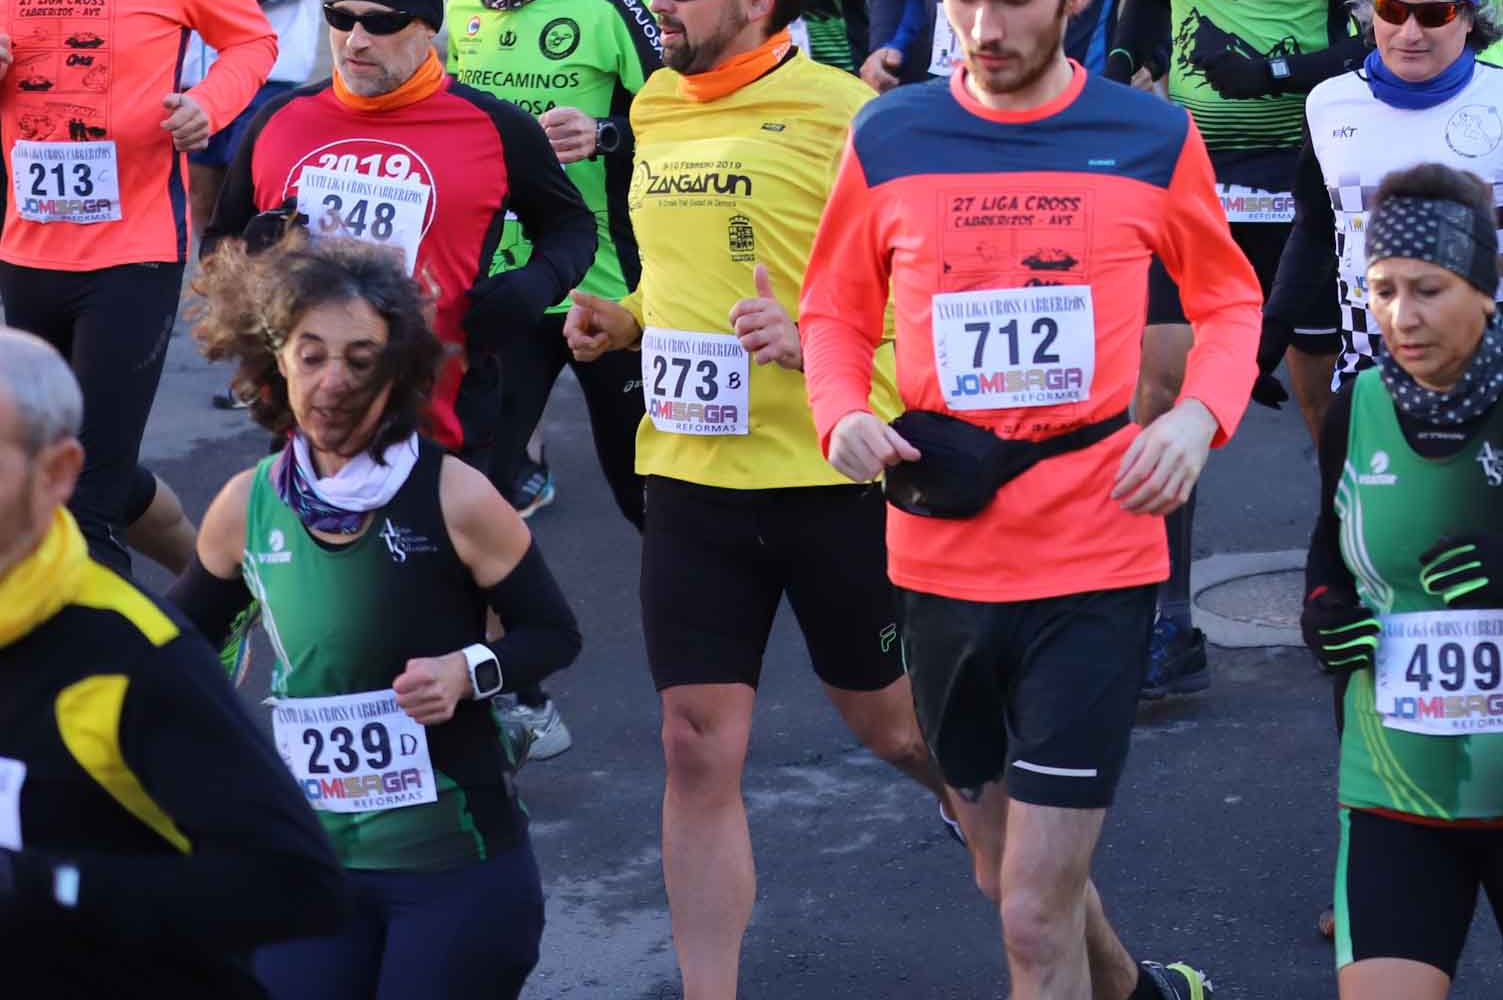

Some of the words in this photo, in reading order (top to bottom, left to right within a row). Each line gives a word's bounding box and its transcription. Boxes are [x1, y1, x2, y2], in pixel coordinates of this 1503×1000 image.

[318, 153, 411, 178] 2019
[29, 162, 94, 197] 213
[953, 196, 975, 212] 27
[981, 196, 1019, 211] LIGA
[1025, 195, 1081, 211] CROSS
[319, 194, 396, 240] 348
[989, 297, 1022, 316] CROSS
[1024, 295, 1087, 313] CABRERIZOS
[691, 341, 743, 358] CABRERIZOS
[964, 317, 1061, 369] 712
[653, 355, 719, 402] 273
[727, 371, 742, 390] B
[950, 367, 1084, 397] JOMISAGA
[650, 399, 738, 423] OMISAGA
[675, 423, 737, 432] REFORMAS
[1430, 620, 1463, 637] CROSS
[1405, 642, 1502, 692] 499
[318, 704, 350, 722] CROSS
[302, 722, 392, 774] 239
[400, 733, 418, 756] D
[303, 768, 423, 801] OMISAGA
[353, 792, 425, 809] REFORMAS
